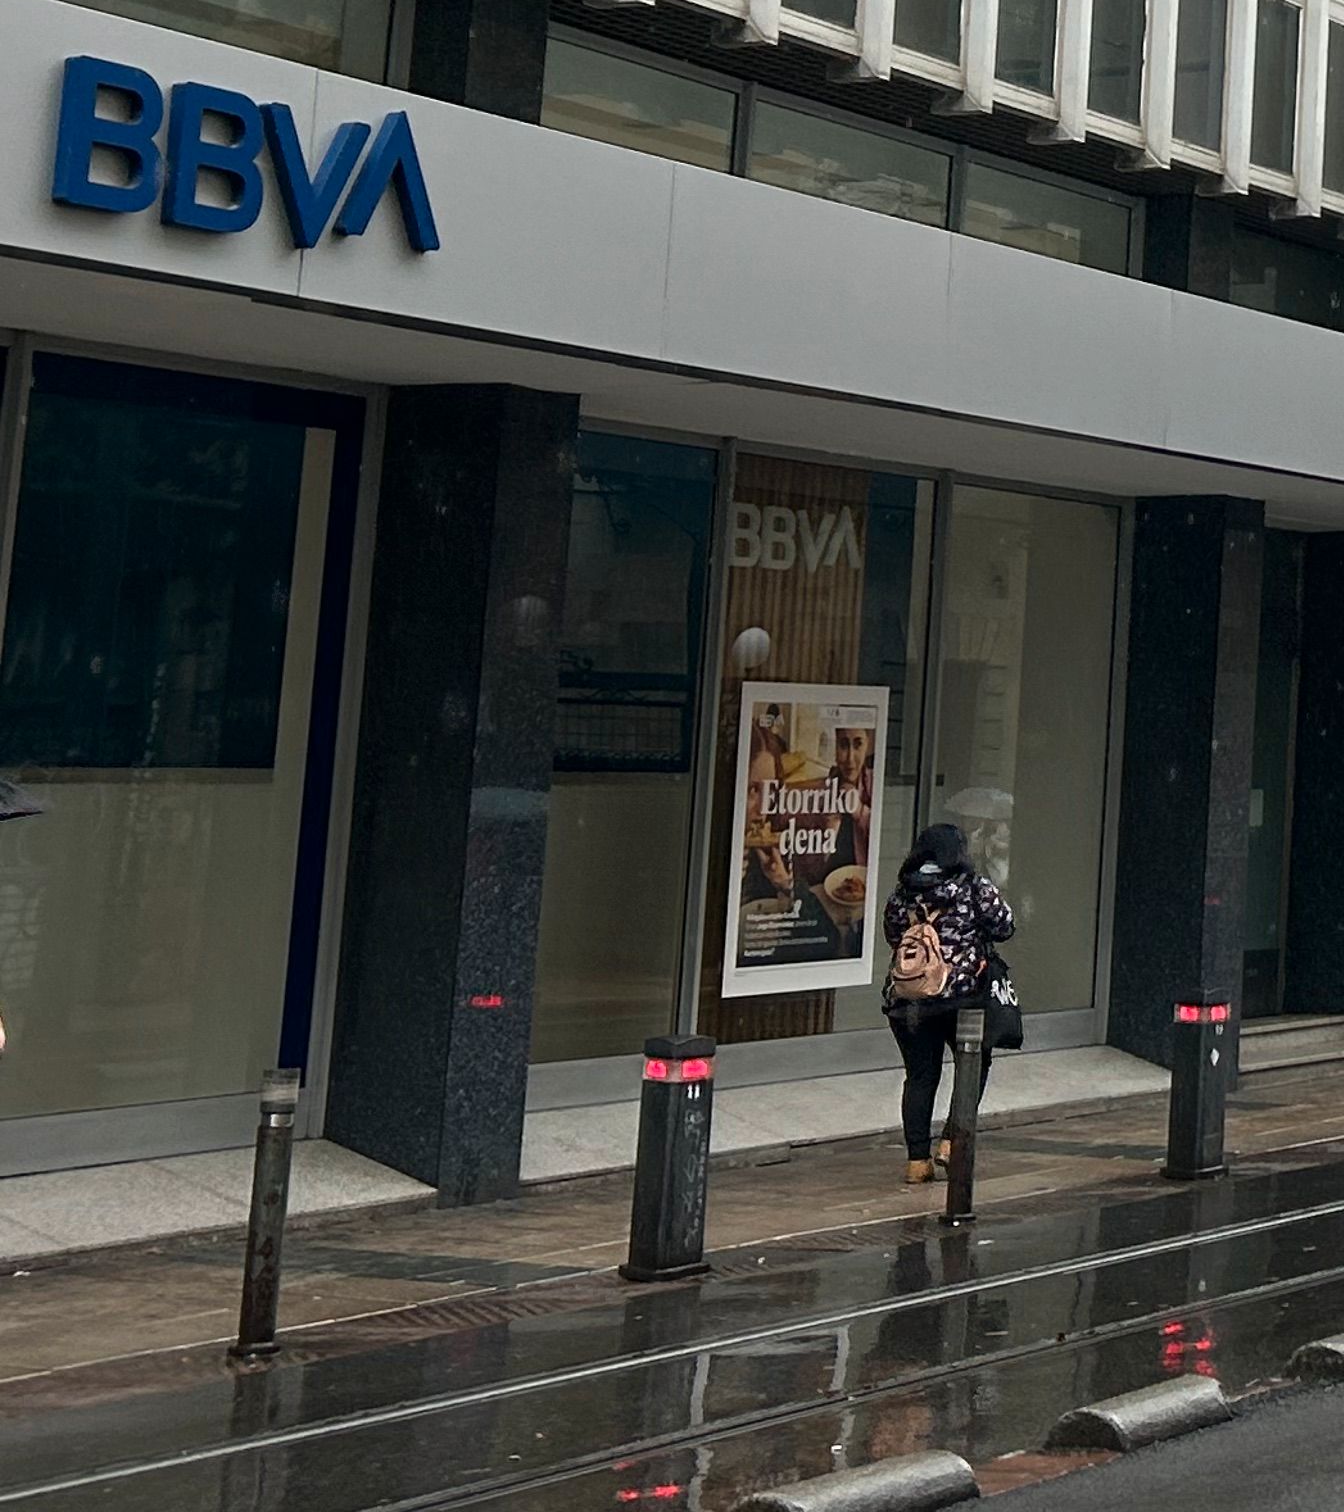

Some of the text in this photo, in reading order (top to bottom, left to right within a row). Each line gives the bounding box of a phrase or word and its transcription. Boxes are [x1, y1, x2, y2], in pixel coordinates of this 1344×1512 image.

[52, 55, 440, 252] BBVA
[727, 501, 862, 573] BBVA
[761, 777, 860, 815] Etorriko
[779, 819, 838, 856] dena
